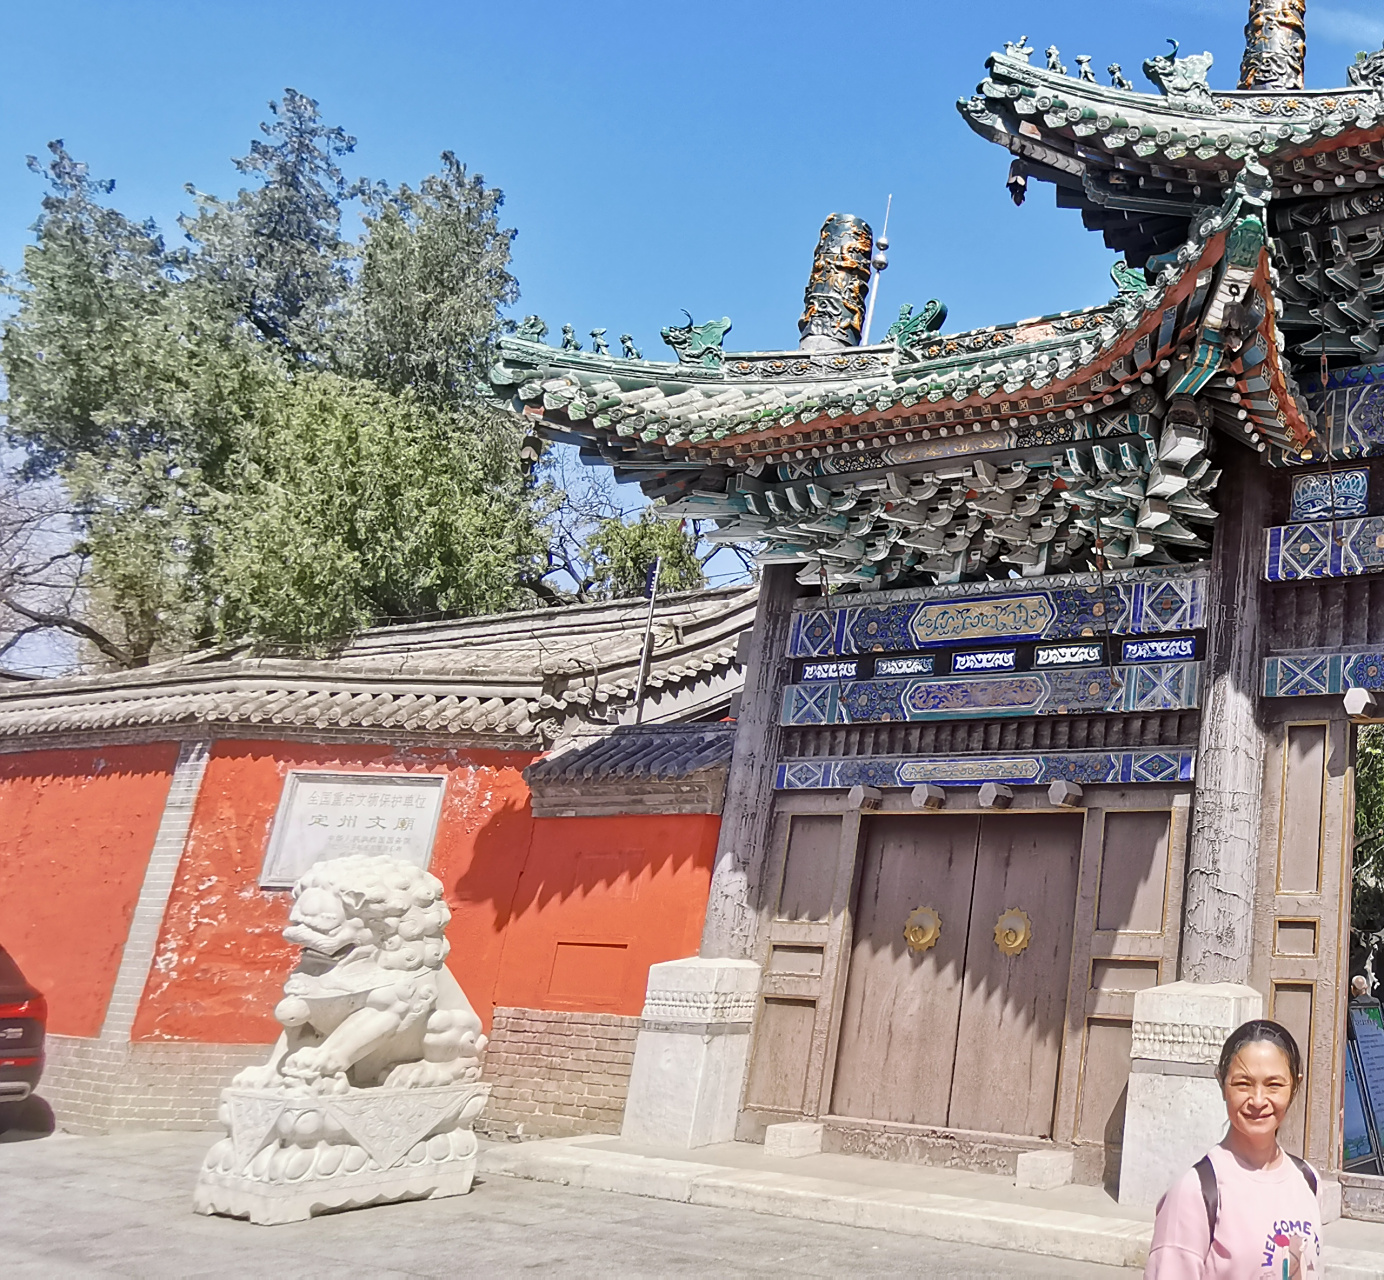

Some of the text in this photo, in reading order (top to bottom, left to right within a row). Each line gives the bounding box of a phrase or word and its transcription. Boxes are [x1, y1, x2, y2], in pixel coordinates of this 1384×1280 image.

[308, 791, 426, 809] 全国重点文物保护单位
[1261, 1220, 1312, 1267] WELCOME
